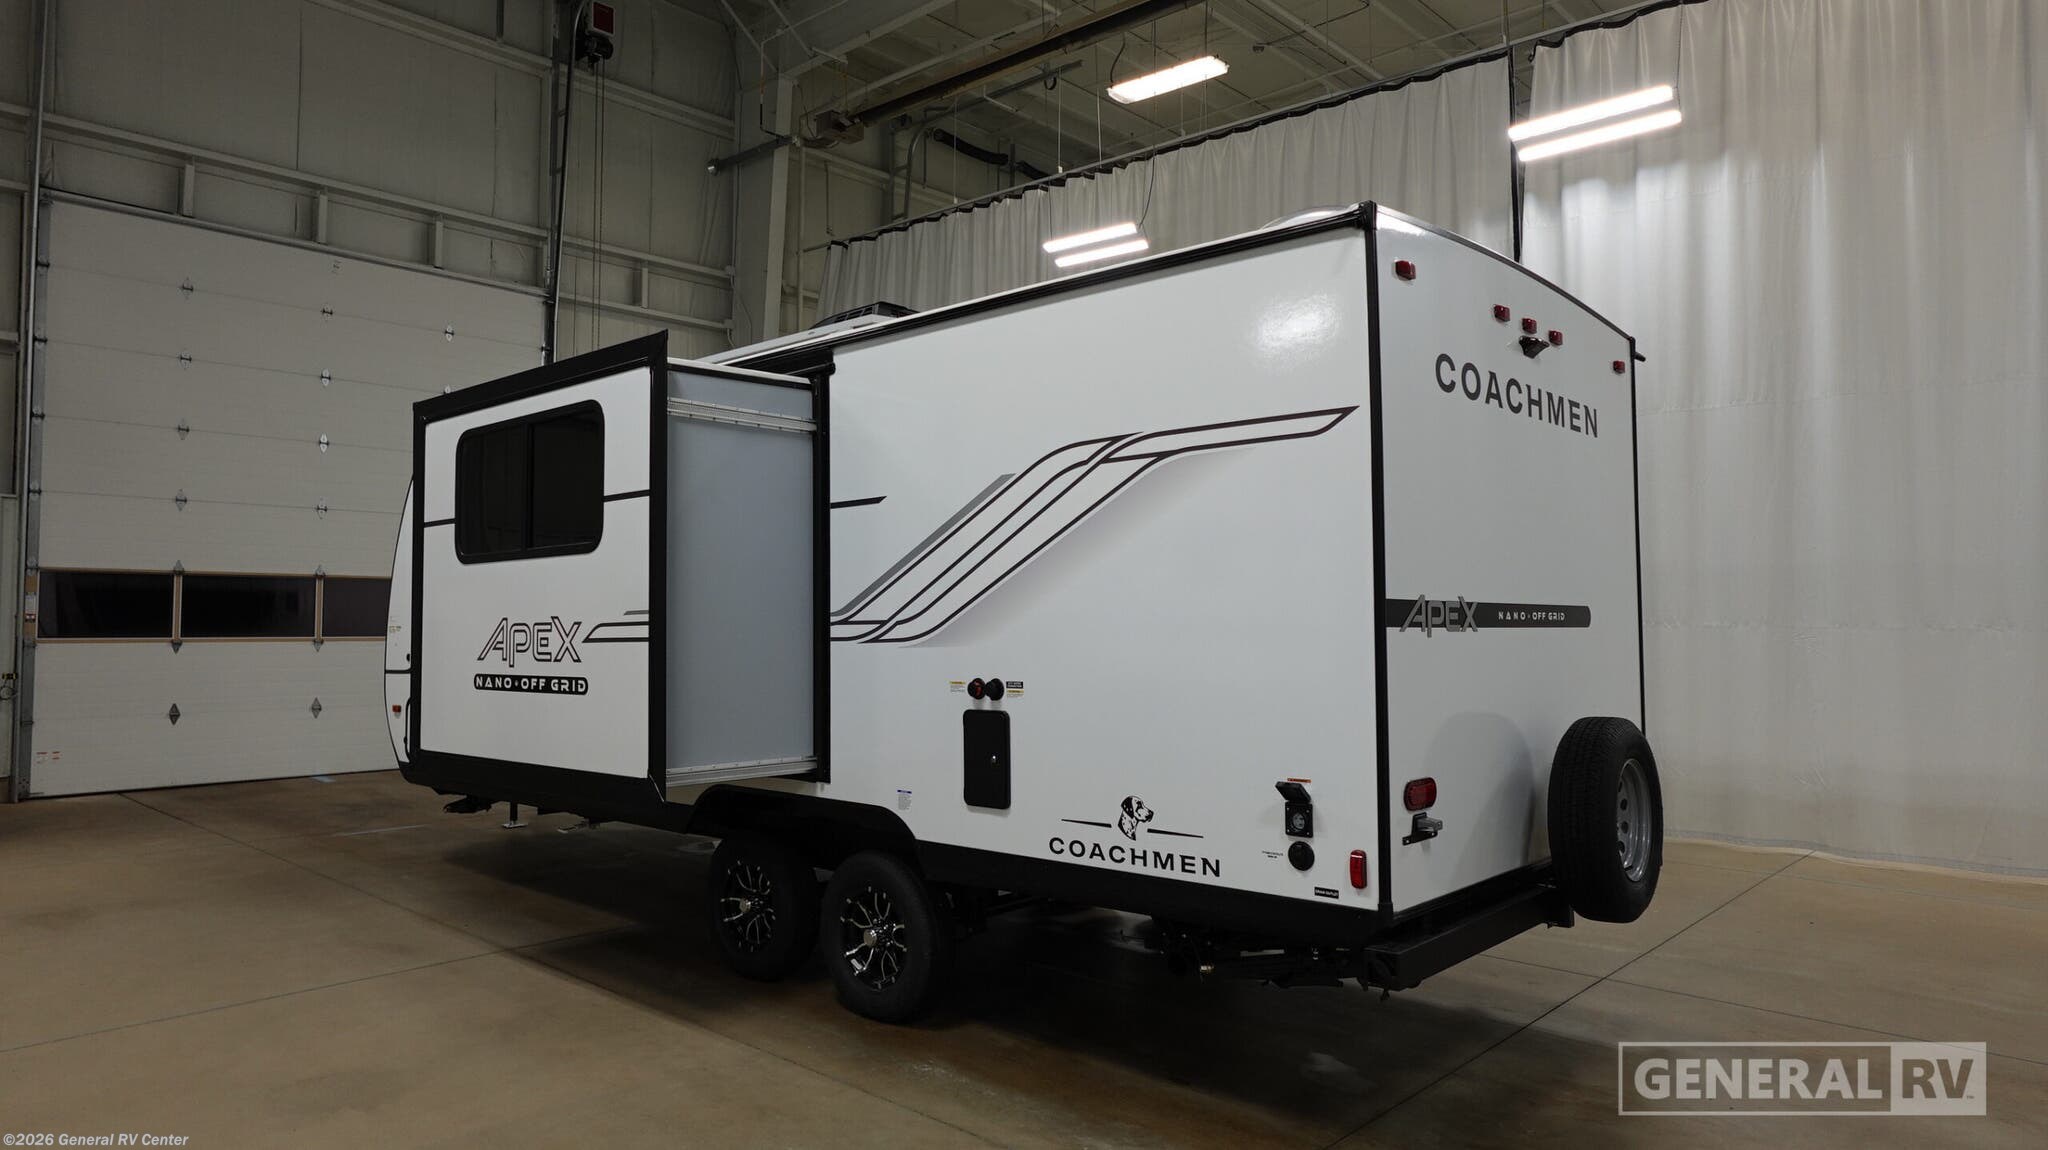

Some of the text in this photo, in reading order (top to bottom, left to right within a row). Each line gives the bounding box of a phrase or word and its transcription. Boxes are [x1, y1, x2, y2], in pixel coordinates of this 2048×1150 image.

[1435, 353, 1599, 438] COACHMEN
[1498, 611, 1566, 621] NANO OFF GRID
[477, 616, 582, 668] APEX
[475, 676, 587, 693] NANO OFF GRID
[1049, 836, 1220, 878] COACHMEN
